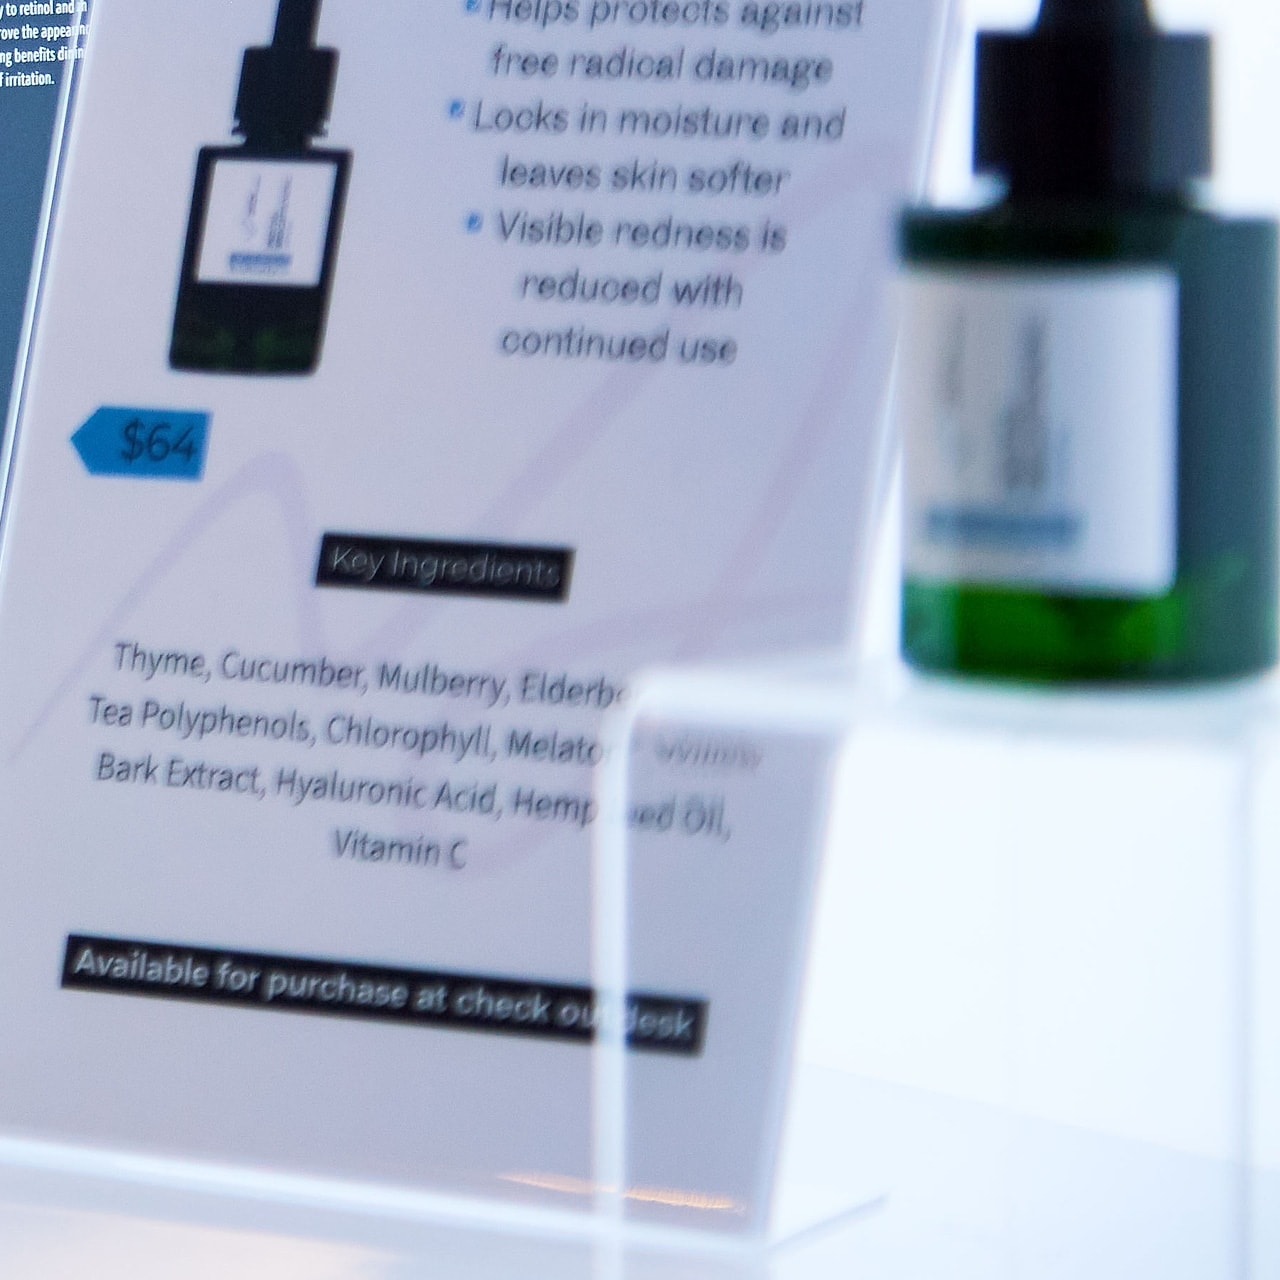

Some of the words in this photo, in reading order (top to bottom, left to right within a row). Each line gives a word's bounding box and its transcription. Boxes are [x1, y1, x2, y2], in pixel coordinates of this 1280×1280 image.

[6, 4, 17, 17] to
[19, 1, 53, 16] retinol
[55, 0, 75, 14] and
[21, 24, 39, 39] the
[14, 47, 56, 63] benefits
[490, 41, 559, 77] free
[569, 46, 686, 80] radical
[693, 50, 834, 91] damage
[6, 72, 55, 87] irritation.
[471, 99, 569, 134] Locks
[579, 103, 607, 134] in
[617, 105, 770, 140] moisture
[778, 107, 848, 142] and
[499, 153, 601, 191] leaves
[611, 159, 678, 193] skin
[688, 160, 790, 197] softer
[498, 210, 603, 248] Visible
[613, 215, 750, 252] redness
[759, 218, 787, 254] is
[520, 268, 664, 306] reduced
[672, 273, 744, 308] with
[500, 326, 671, 363] continued
[679, 338, 737, 367] use
[121, 417, 197, 464] $64
[332, 545, 385, 581] Key
[392, 550, 561, 589] Ingredients
[115, 641, 211, 683] Thyme,
[221, 651, 368, 696] Cucumber,
[377, 663, 511, 708] Mulberry,
[89, 695, 134, 727] Tea
[141, 701, 318, 748] Polyphenols,
[326, 714, 498, 763] Chlorophyll,
[506, 727, 610, 767] Melato
[95, 751, 159, 785] Bark
[165, 758, 267, 802] Extract,
[275, 767, 427, 810] Hyaluronic
[434, 779, 502, 822] Acid,
[511, 786, 599, 831] Hemp
[685, 793, 732, 843] Oil,
[333, 828, 440, 868] Vitamin
[449, 836, 468, 870] C
[74, 948, 210, 989] Available
[215, 960, 261, 994] for
[265, 971, 409, 1010] purchase
[415, 984, 448, 1013] at
[456, 987, 552, 1024] check
[558, 1001, 600, 1029] ou
